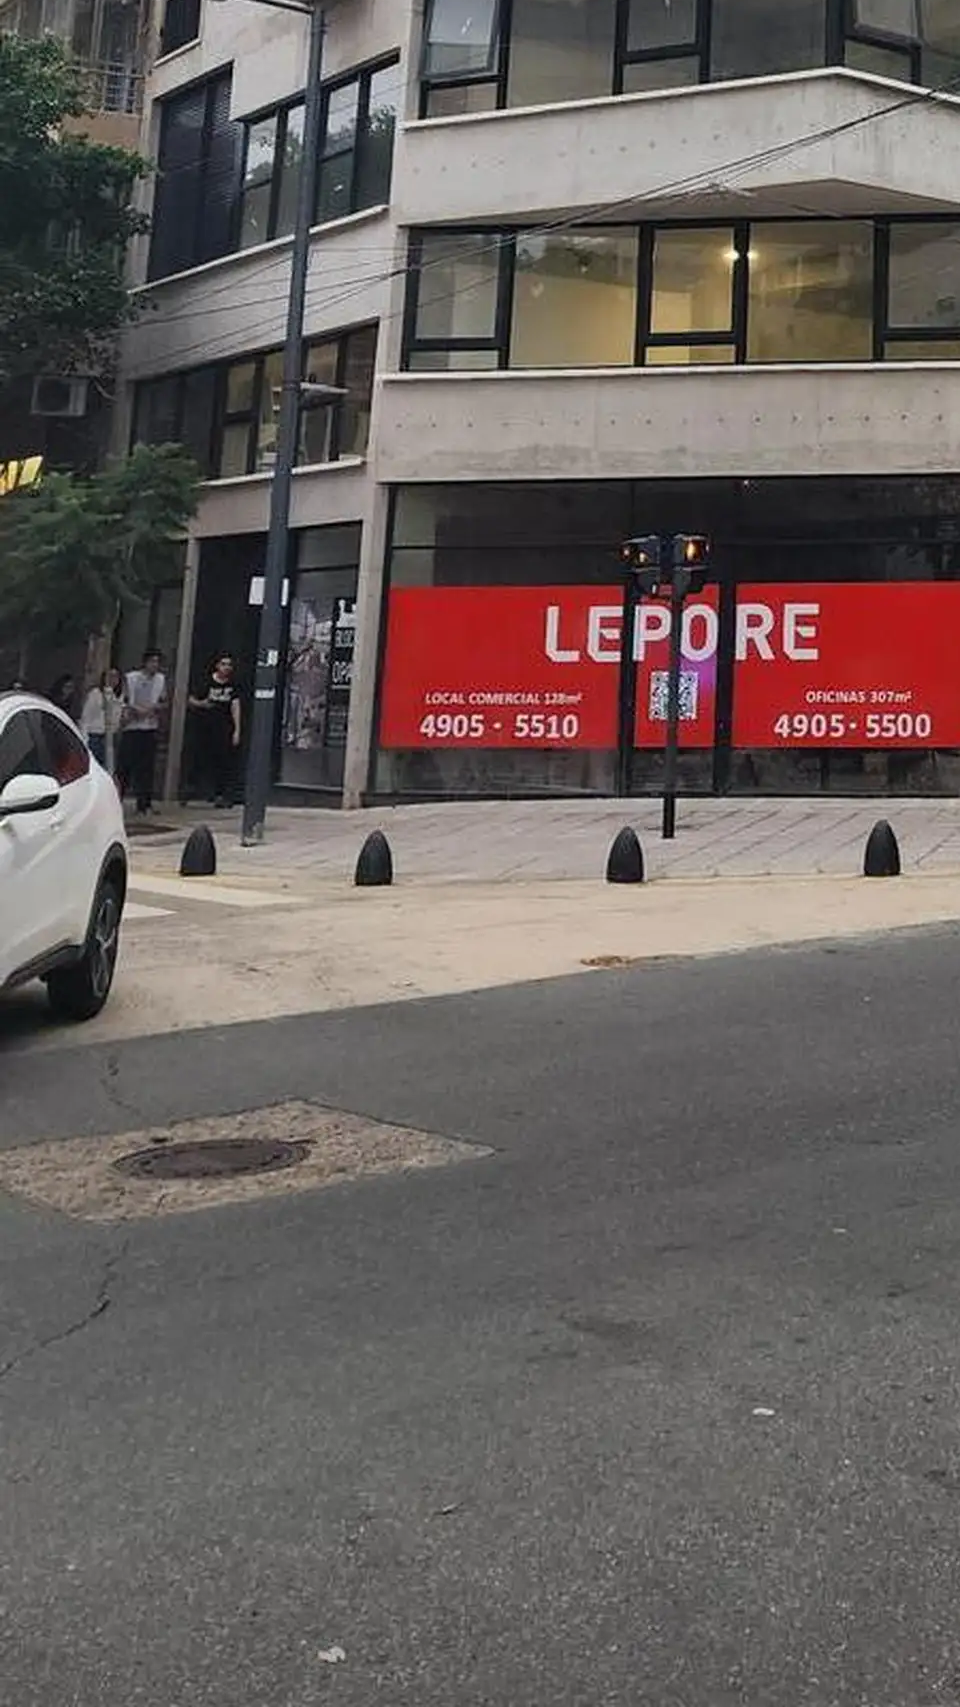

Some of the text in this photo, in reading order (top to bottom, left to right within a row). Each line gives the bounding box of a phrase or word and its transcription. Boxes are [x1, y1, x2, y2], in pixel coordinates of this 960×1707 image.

[545, 604, 820, 662] LEPORE
[425, 692, 466, 705] LOCAL
[468, 692, 540, 705] COMERCIAL
[806, 690, 866, 703] OFICINAS
[420, 714, 485, 739] 4905
[514, 713, 579, 739] 5510
[774, 713, 845, 738] 4905
[865, 713, 931, 738] 5500
